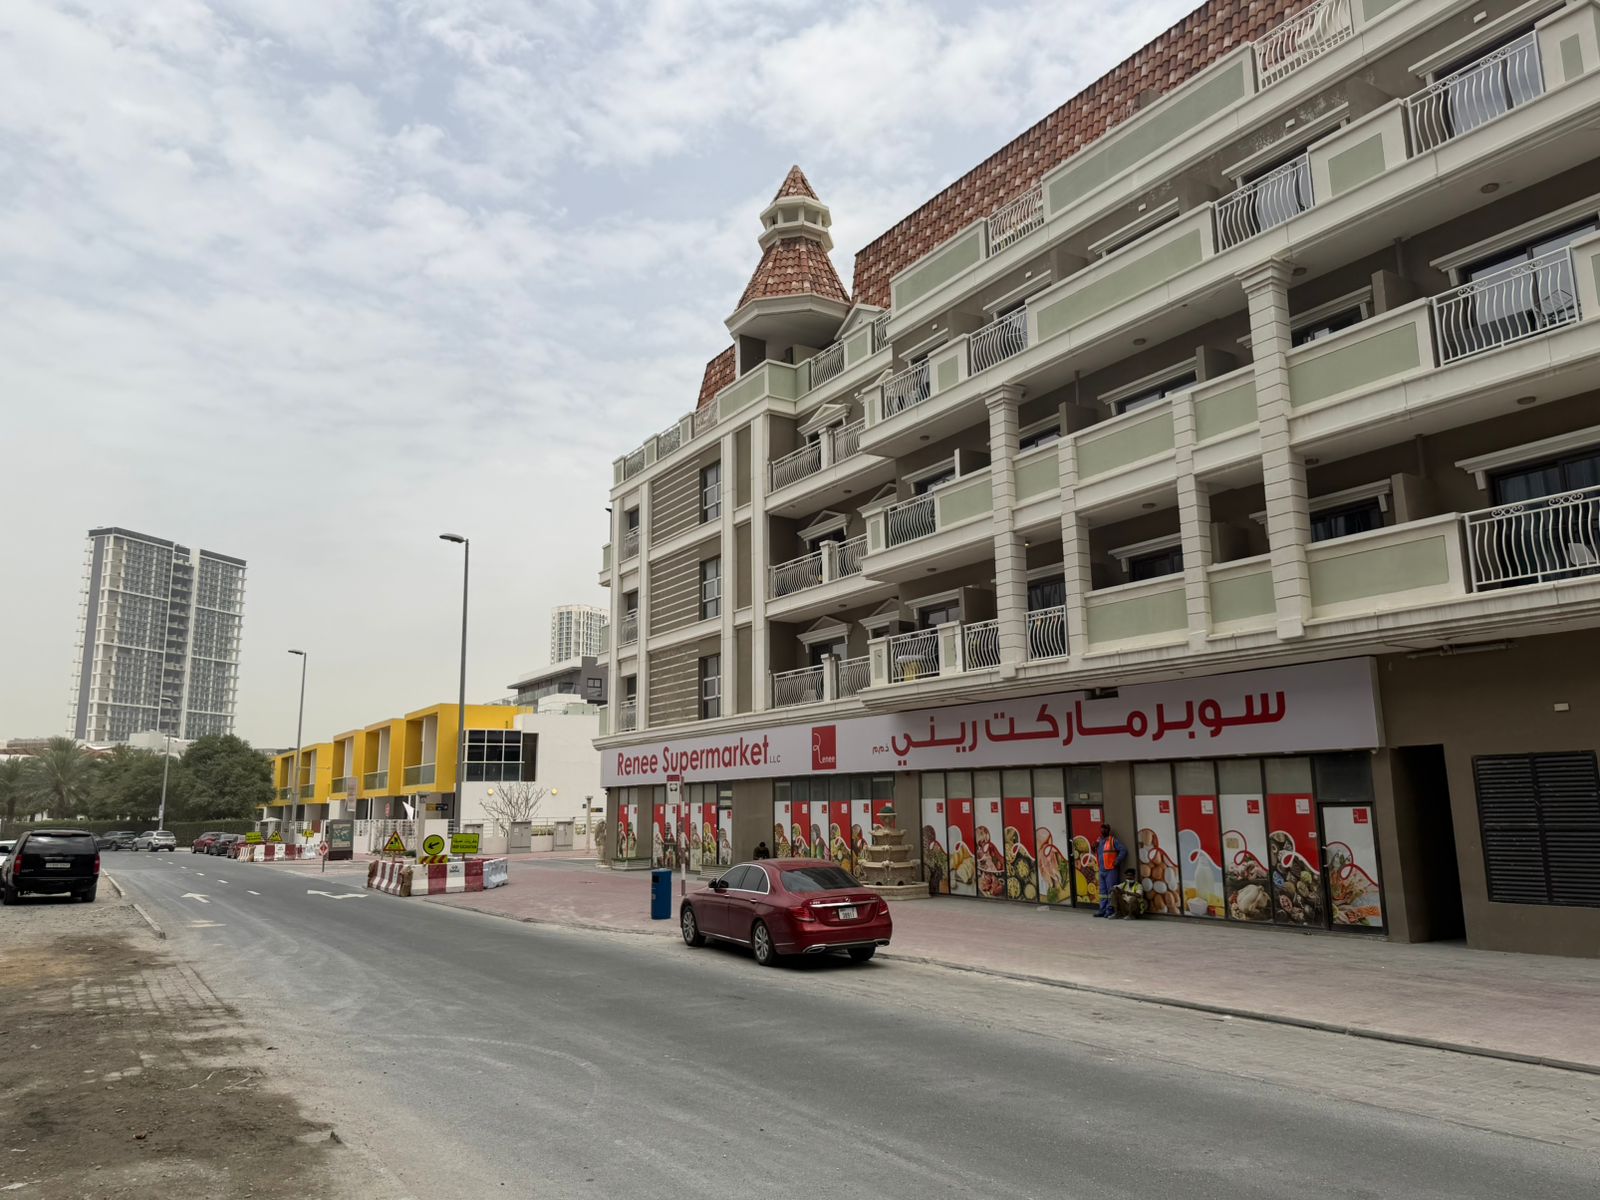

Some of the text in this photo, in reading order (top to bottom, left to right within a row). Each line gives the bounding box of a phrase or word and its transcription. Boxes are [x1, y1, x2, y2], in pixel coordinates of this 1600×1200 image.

[617, 752, 658, 776] Renee
[662, 734, 769, 776] Supermarket
[813, 732, 835, 764] Renee
[891, 716, 978, 766] ريني
